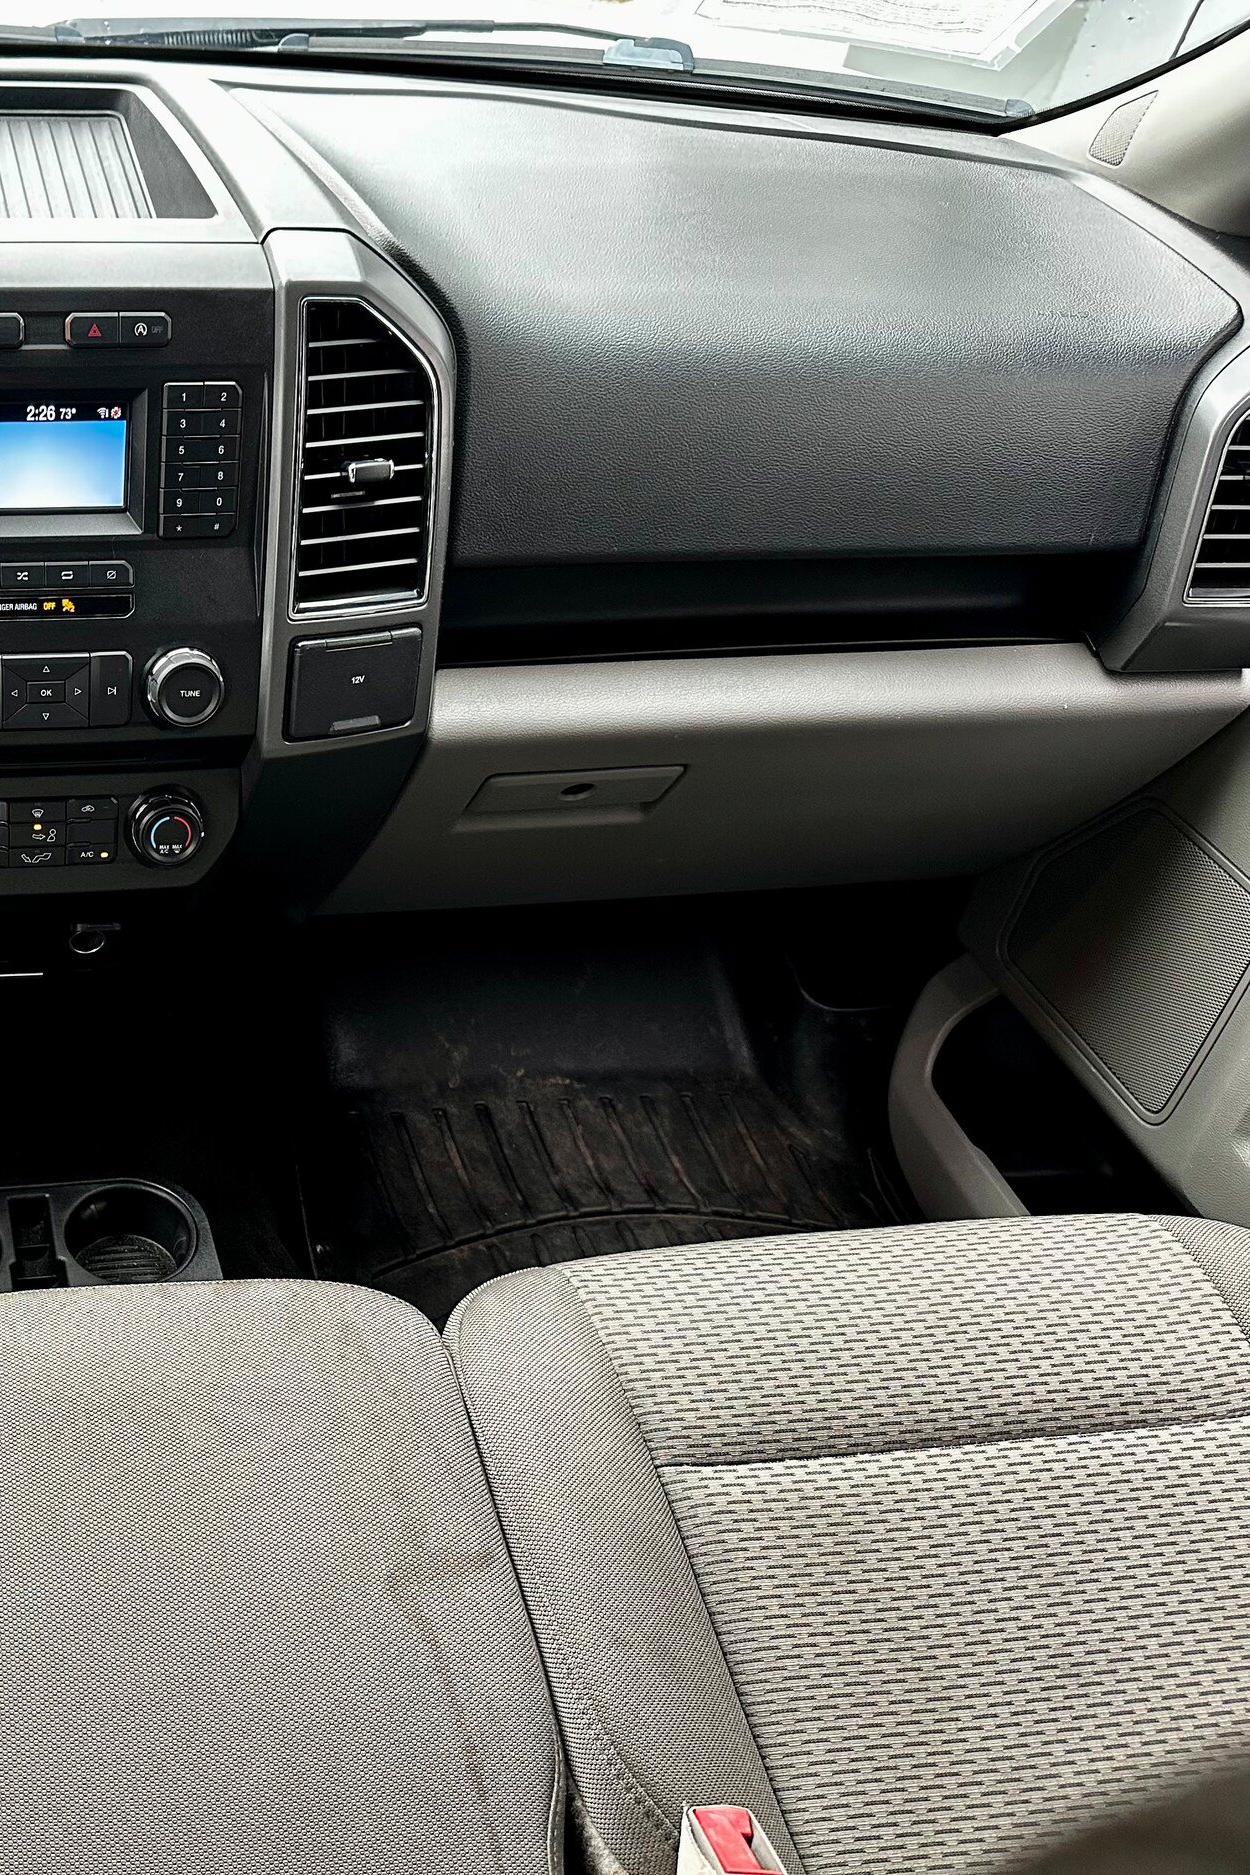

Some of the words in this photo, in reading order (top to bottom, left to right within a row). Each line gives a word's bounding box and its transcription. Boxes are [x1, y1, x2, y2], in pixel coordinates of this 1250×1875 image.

[182, 392, 187, 402] 1
[220, 392, 227, 402] 2
[26, 405, 56, 421] 2:26
[180, 419, 187, 428] 3
[219, 419, 226, 428] 4
[178, 446, 185, 455] 5
[218, 445, 225, 455] 6
[178, 473, 184, 482] 7
[217, 471, 224, 480] 8
[176, 498, 183, 507] 9
[216, 497, 222, 506] 0
[14, 602, 37, 610] AIRBAG
[43, 602, 56, 610] OFF
[351, 675, 365, 684] 12V
[40, 688, 52, 697] OK
